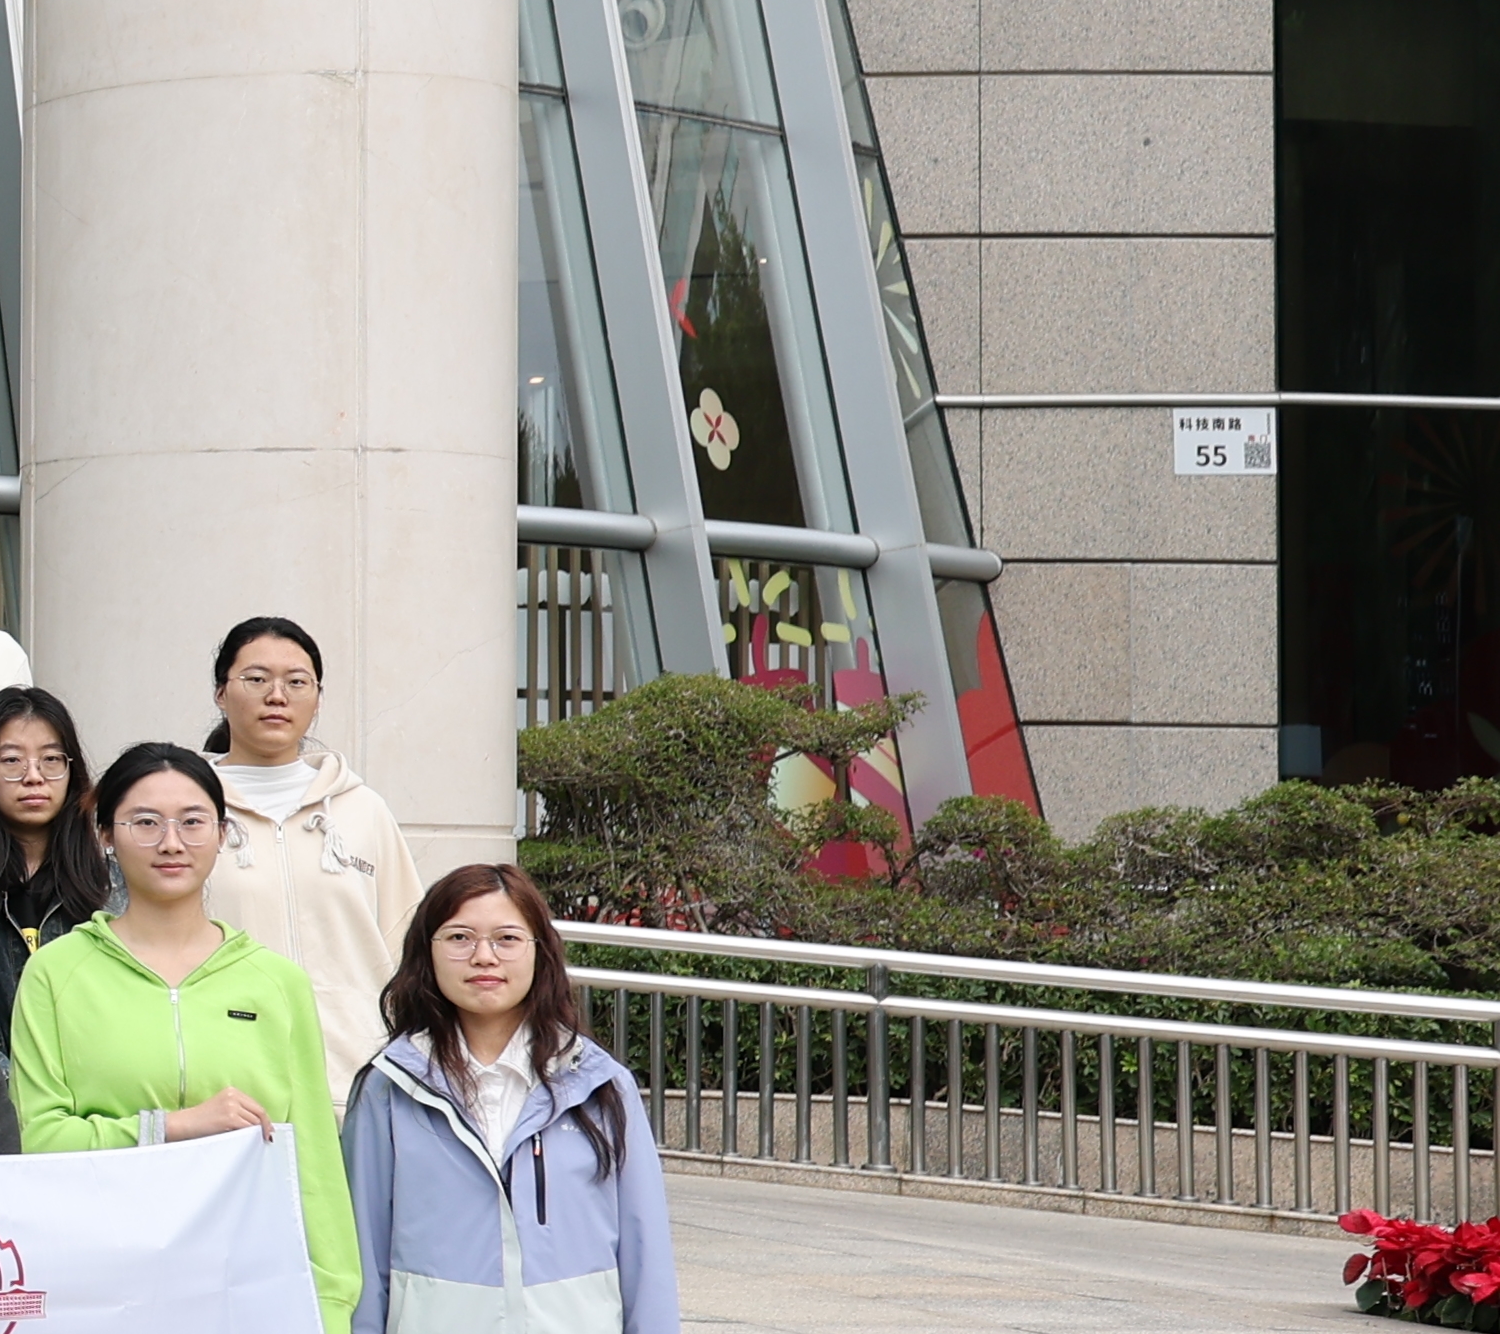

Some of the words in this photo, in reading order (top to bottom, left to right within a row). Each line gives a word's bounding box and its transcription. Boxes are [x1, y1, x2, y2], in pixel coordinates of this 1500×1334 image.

[1179, 416, 1242, 431] 科技南路
[1196, 445, 1228, 467] 55
